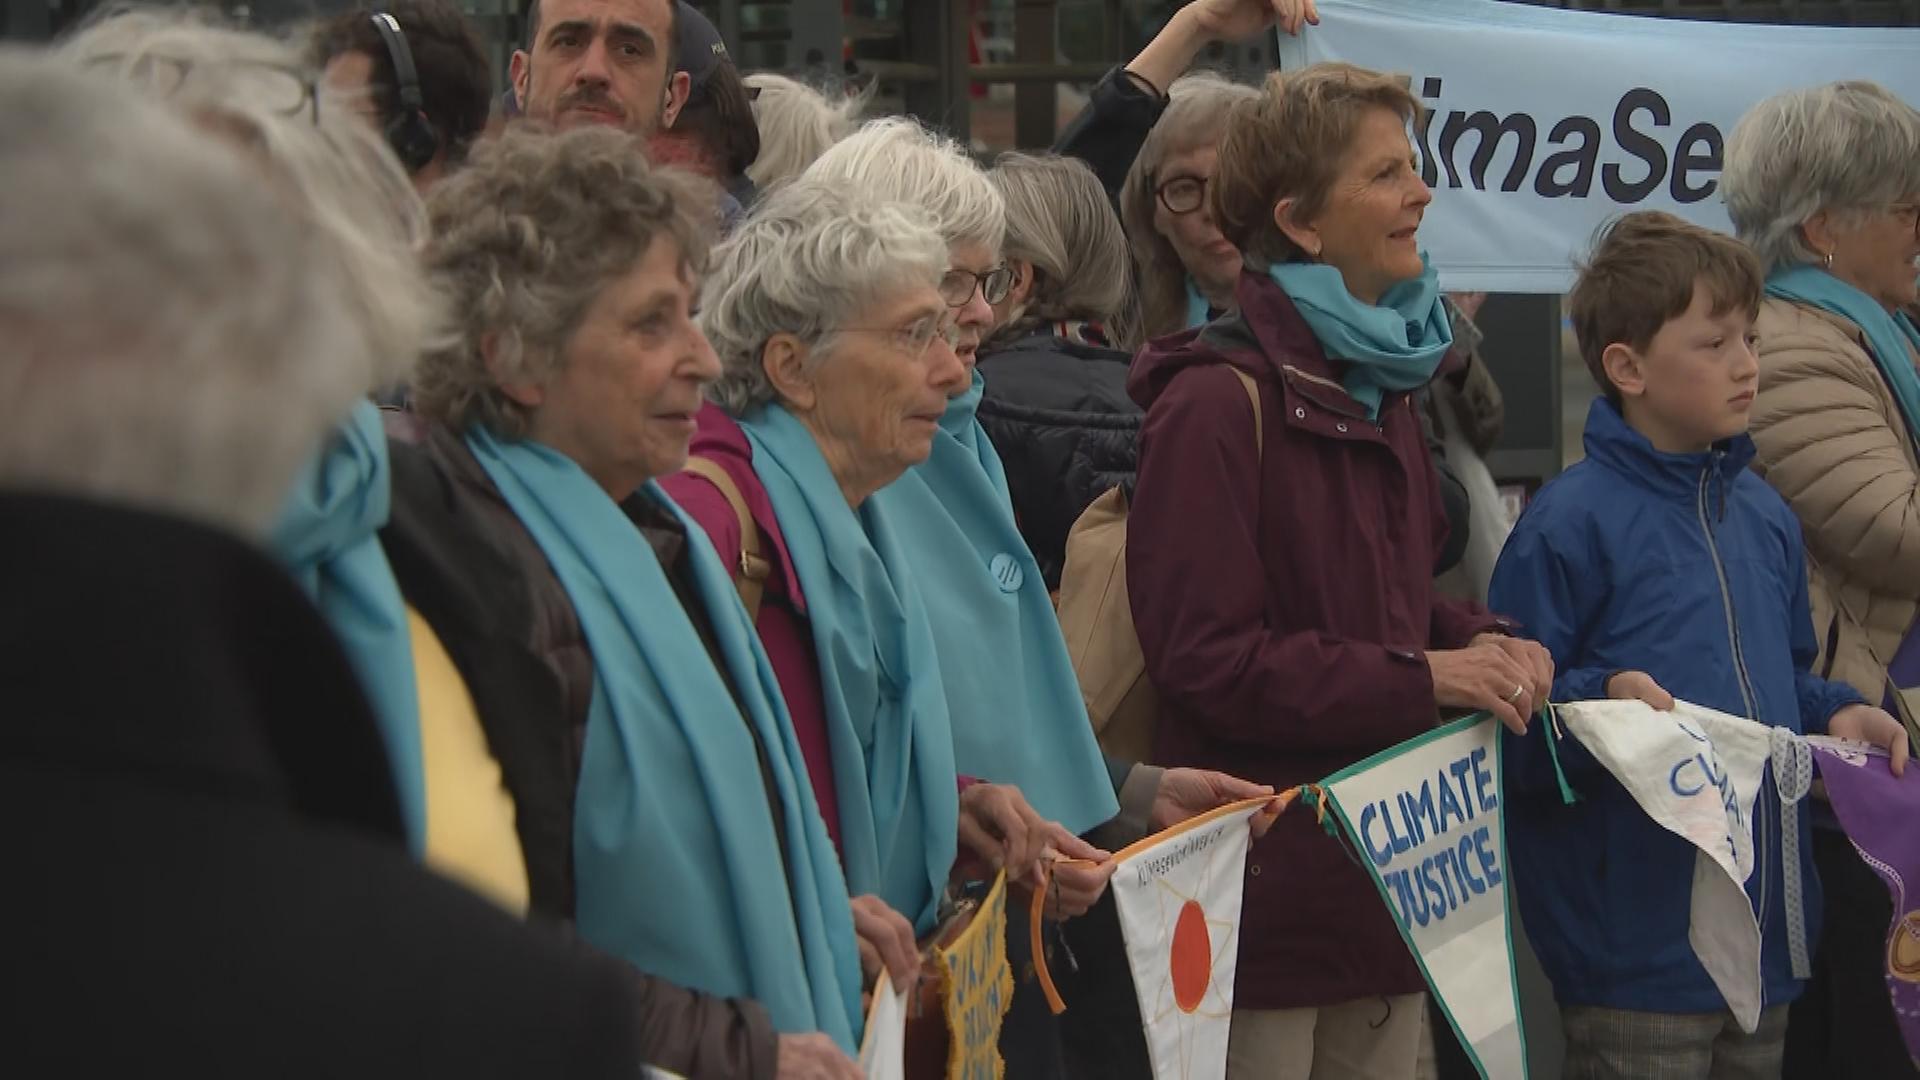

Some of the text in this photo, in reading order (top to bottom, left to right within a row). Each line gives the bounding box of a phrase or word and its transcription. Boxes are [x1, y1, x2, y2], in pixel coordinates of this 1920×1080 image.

[1405, 76, 1724, 203] imaSe
[1360, 746, 1498, 867] CLIMATE
[1384, 826, 1502, 930] JUSTICE
